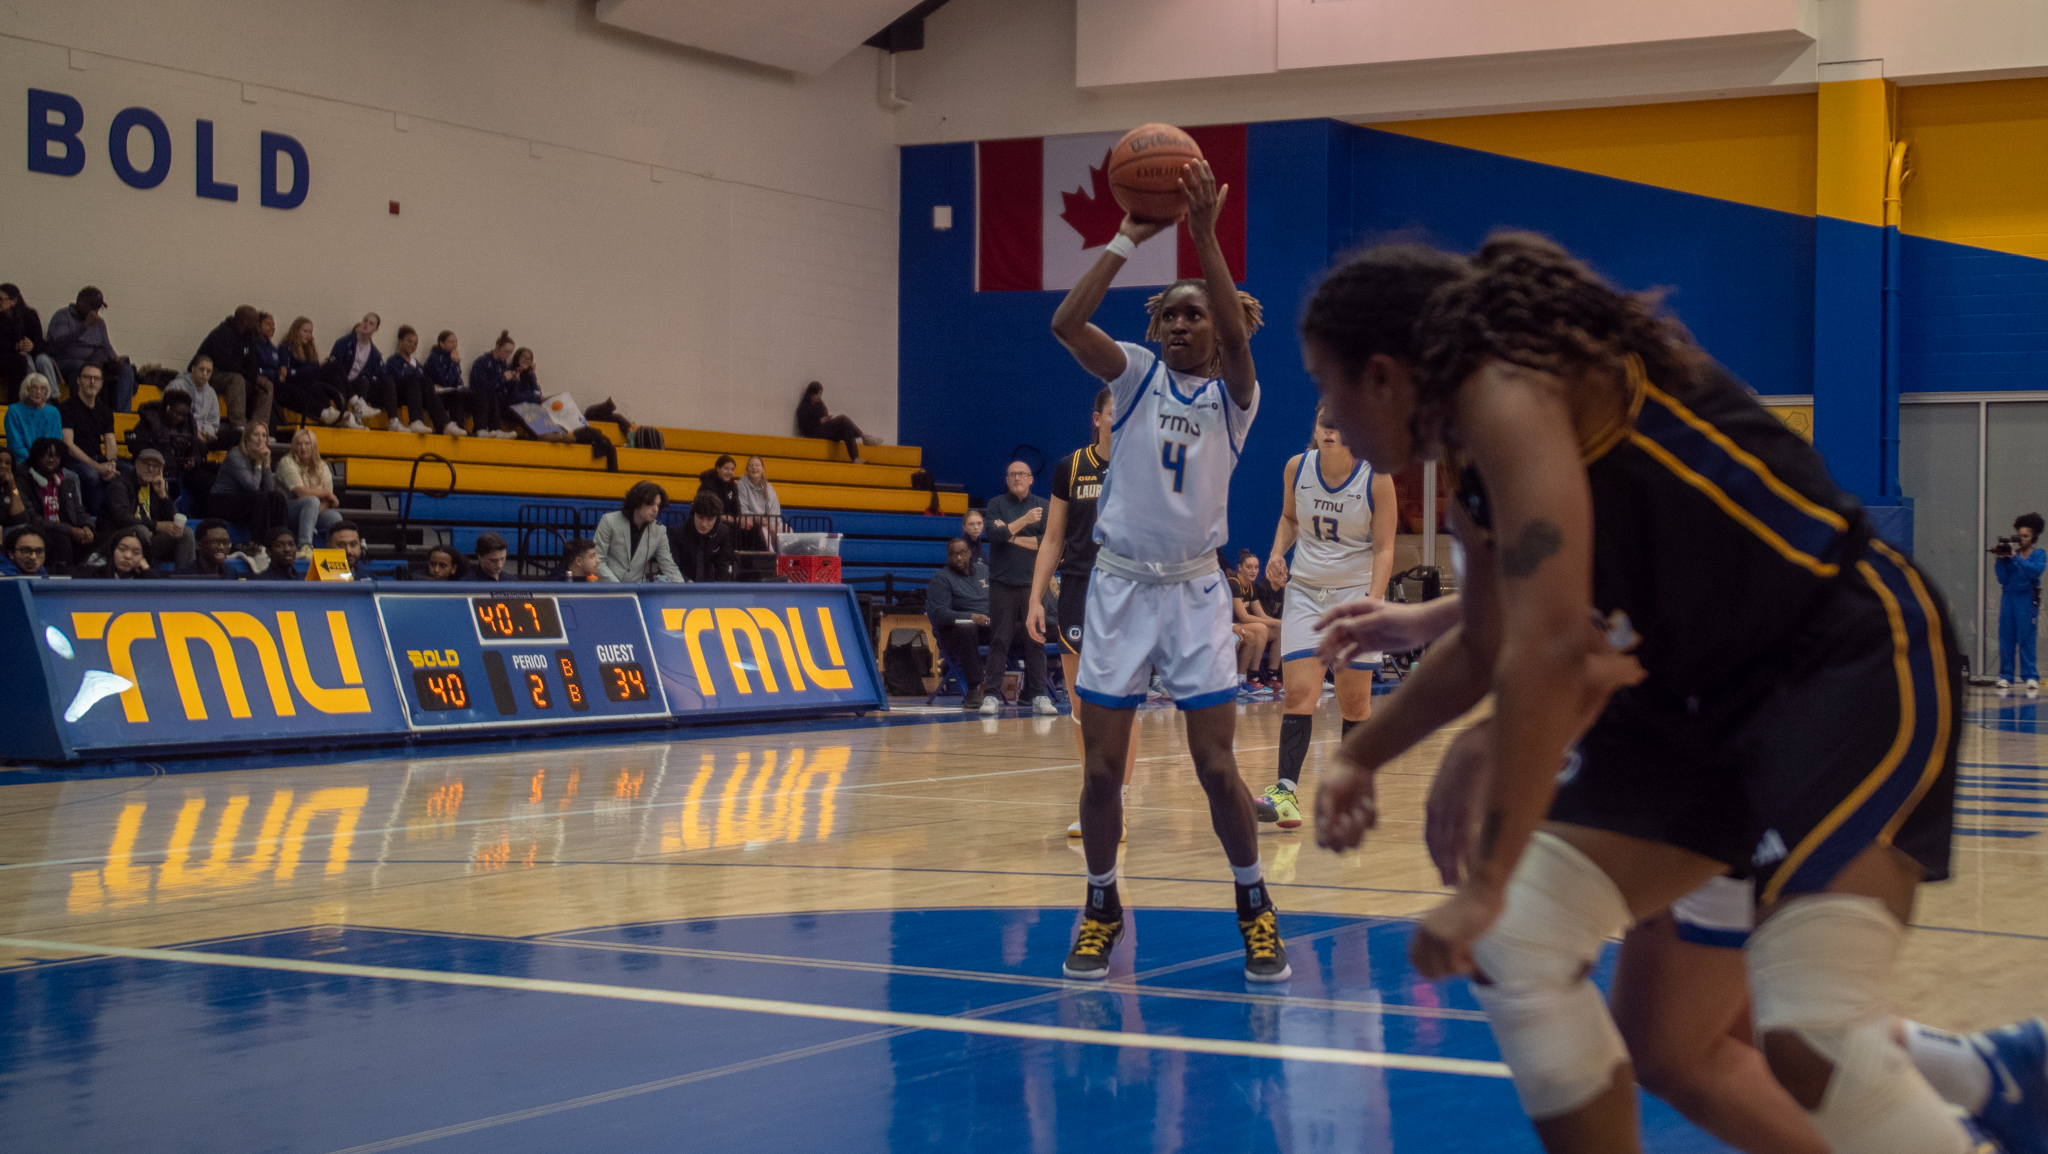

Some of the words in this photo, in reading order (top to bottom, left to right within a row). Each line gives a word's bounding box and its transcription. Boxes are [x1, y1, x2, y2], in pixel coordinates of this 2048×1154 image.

[28, 87, 309, 209] BOLD
[1130, 132, 1193, 153] Wilson
[1159, 414, 1201, 437] TMU
[1161, 439, 1188, 495] 4
[1077, 484, 1103, 499] LAUR
[1314, 499, 1343, 513] TMU
[1312, 515, 1340, 543] 13
[479, 603, 540, 635] 40.7
[407, 649, 460, 668] BOLD
[512, 655, 548, 669] PERIOD
[596, 644, 636, 662] GUEST
[662, 607, 853, 696] TMU
[71, 610, 371, 723] TMU
[428, 673, 466, 707] 40
[530, 674, 547, 706] 2
[613, 667, 646, 698] 34
